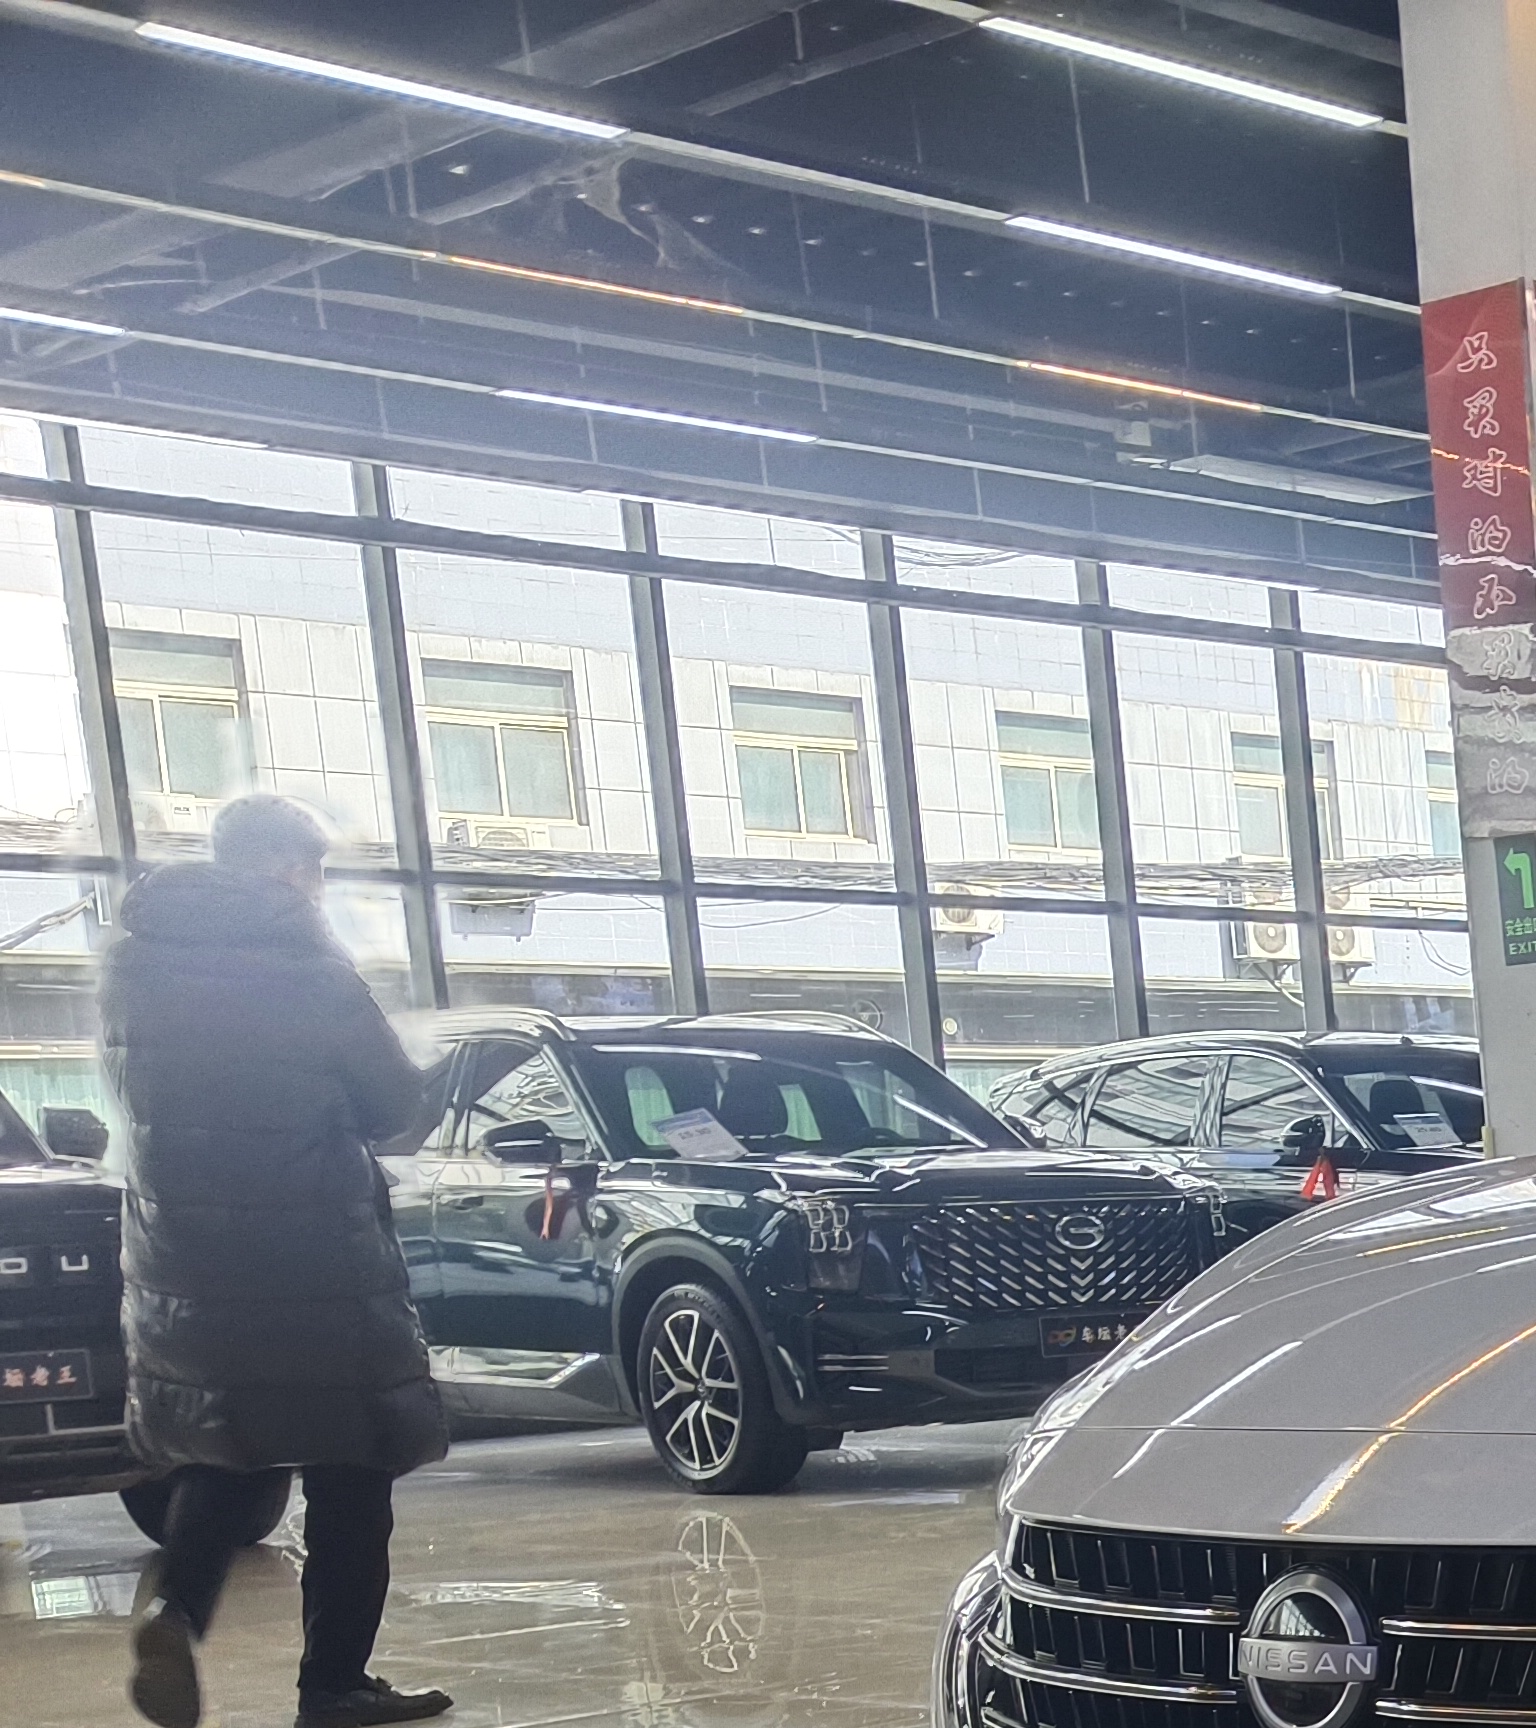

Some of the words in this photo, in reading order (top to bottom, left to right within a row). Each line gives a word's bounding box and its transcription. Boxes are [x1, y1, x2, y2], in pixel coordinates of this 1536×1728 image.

[1081, 1323, 1138, 1343] 车坛老
[1239, 1643, 1374, 1676] NISSAN
